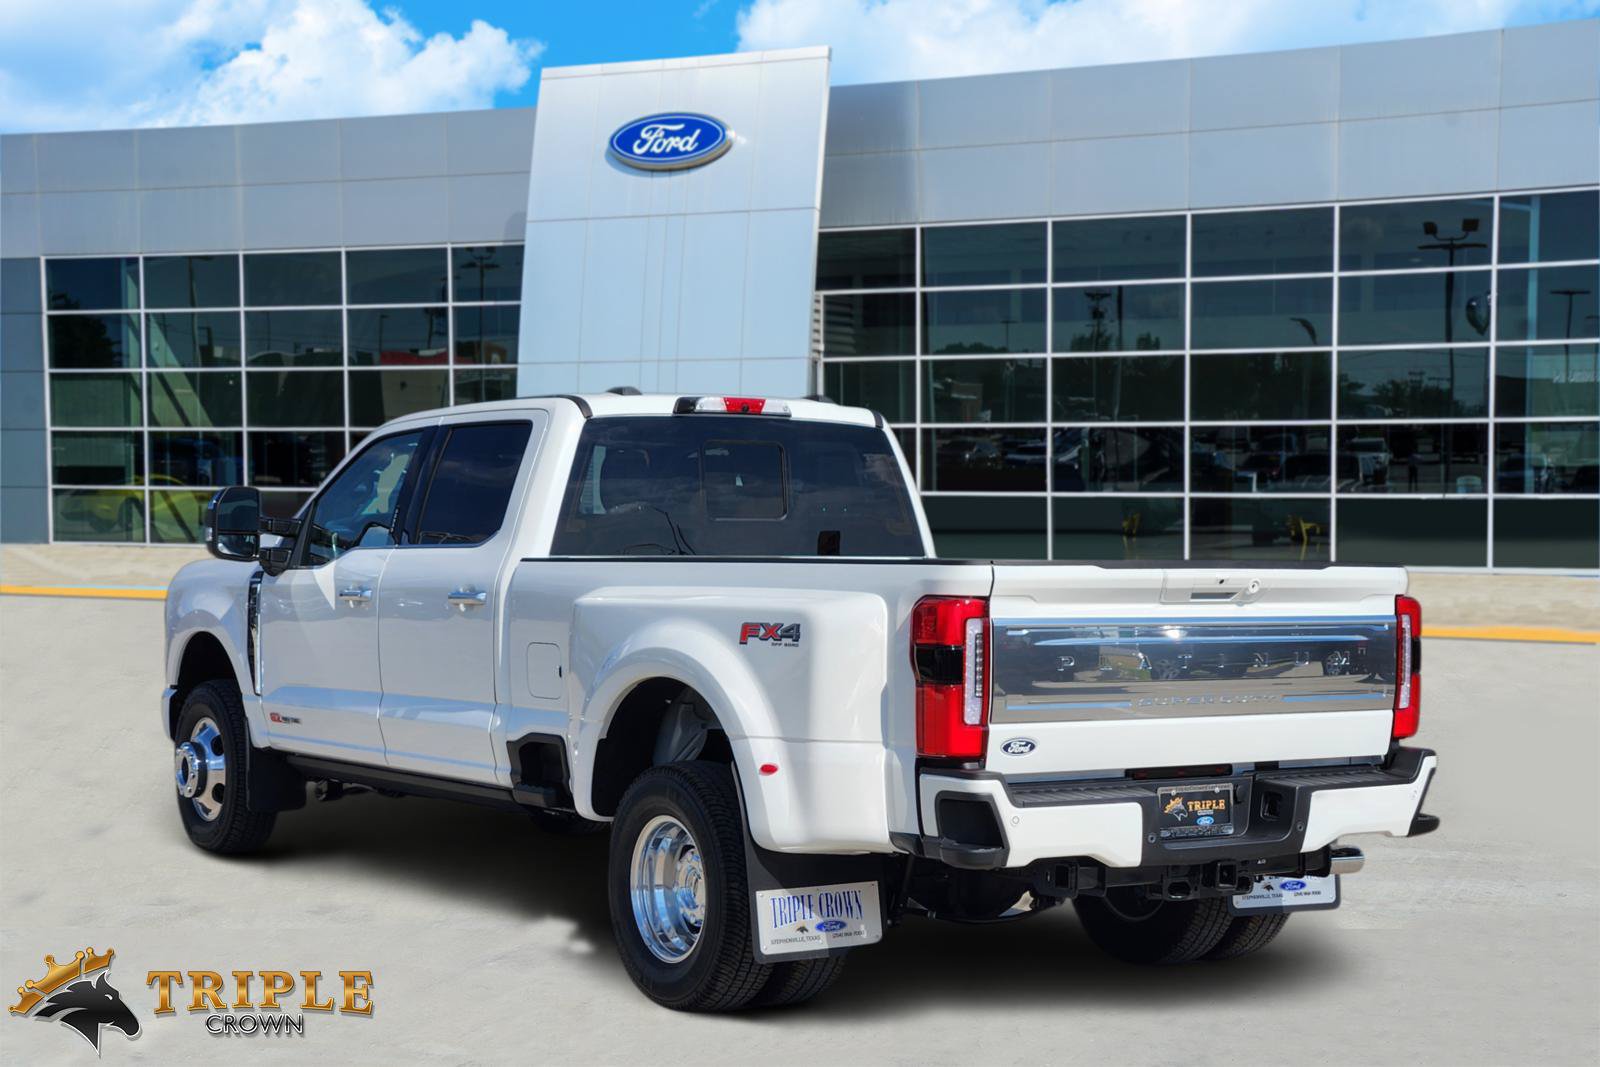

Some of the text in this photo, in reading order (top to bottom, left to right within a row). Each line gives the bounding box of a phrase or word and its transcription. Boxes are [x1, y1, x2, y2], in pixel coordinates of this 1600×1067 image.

[632, 123, 702, 155] Ford
[739, 622, 801, 645] FX4
[1056, 650, 1350, 672] PLATINUM
[1007, 741, 1032, 753] Ford
[1187, 799, 1226, 812] TRIPLE
[770, 890, 864, 929] TRIPLE CROWN
